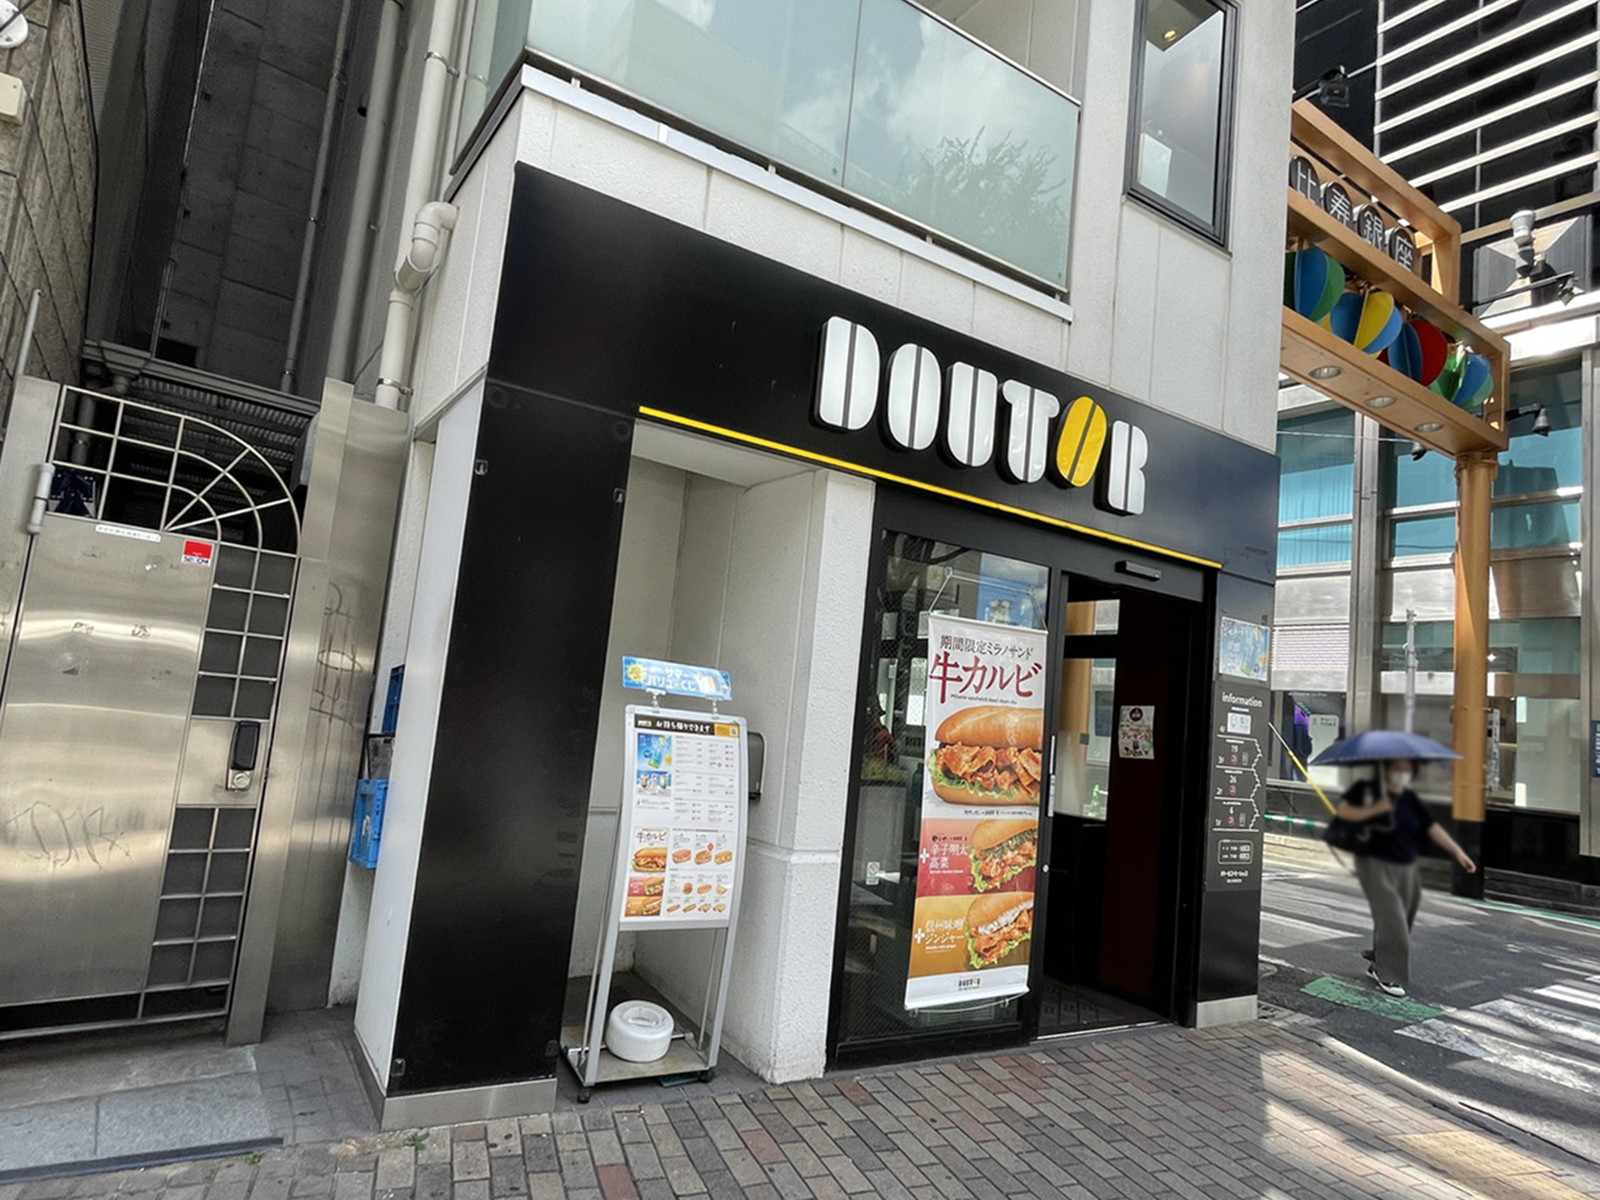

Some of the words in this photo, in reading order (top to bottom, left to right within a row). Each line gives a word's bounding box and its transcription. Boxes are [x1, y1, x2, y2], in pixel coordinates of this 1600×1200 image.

[816, 315, 1149, 516] DOUTOR
[929, 651, 1042, 704] 牛カルビ
